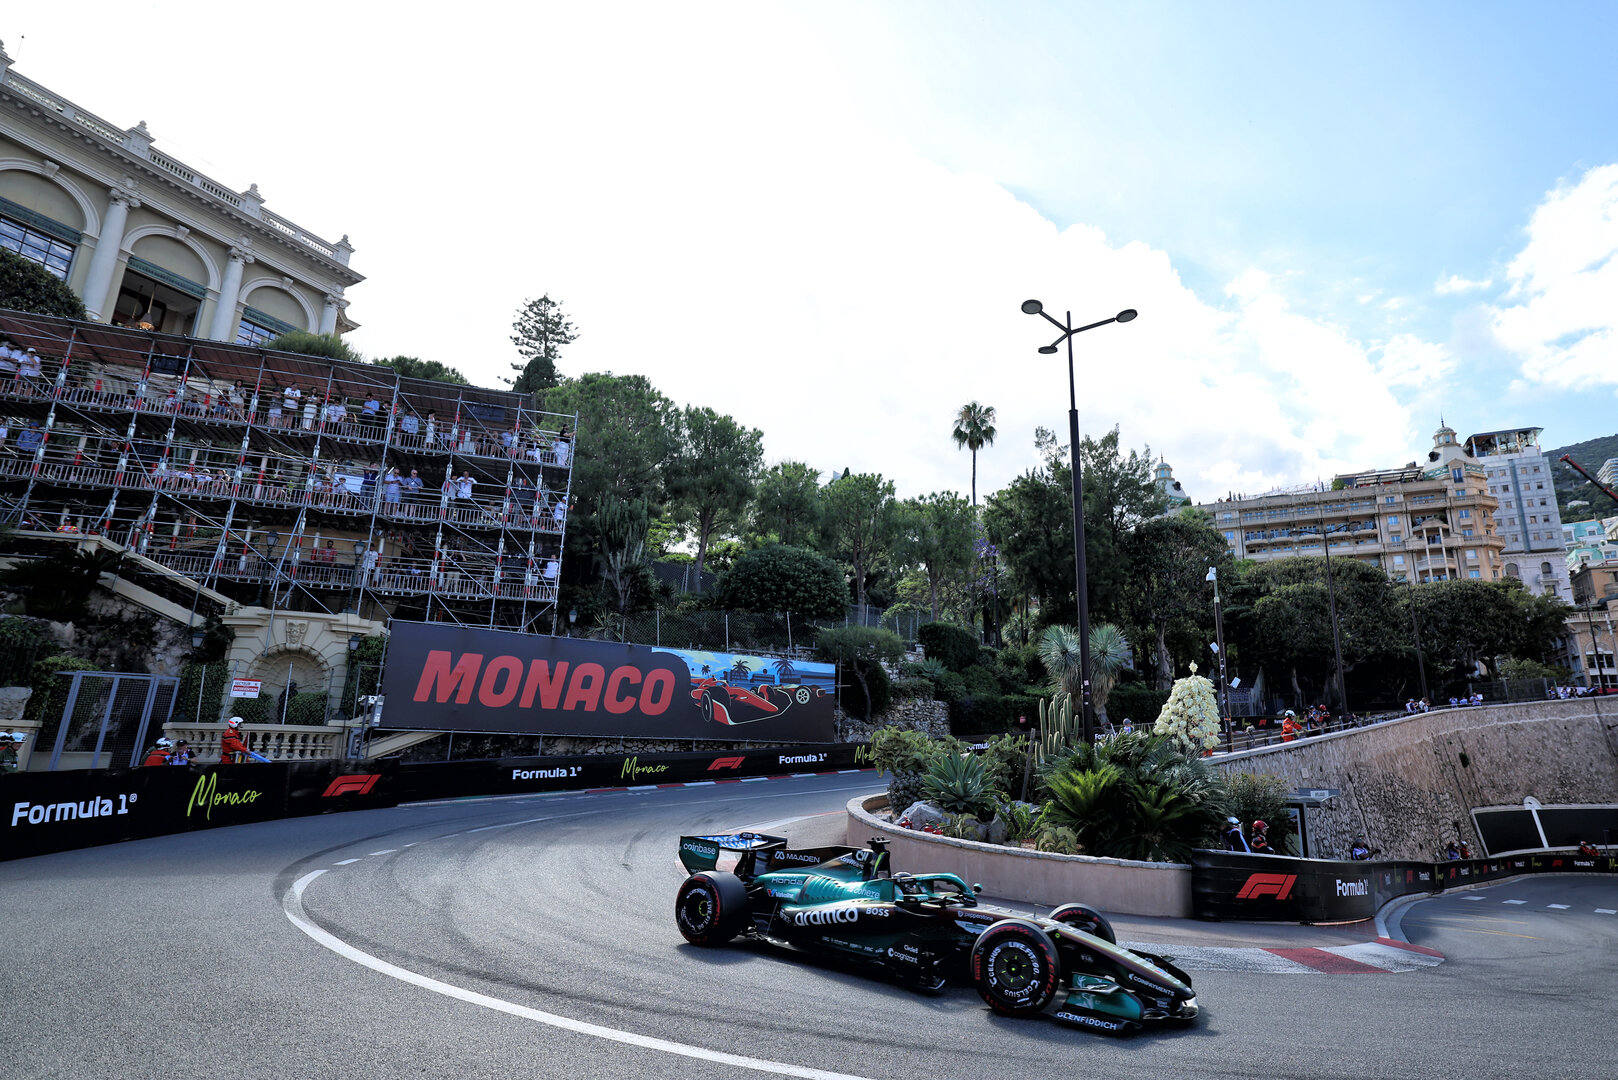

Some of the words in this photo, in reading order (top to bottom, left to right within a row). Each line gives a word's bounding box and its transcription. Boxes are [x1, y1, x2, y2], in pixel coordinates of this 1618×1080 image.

[413, 650, 676, 716] MONACO
[706, 756, 746, 770] F1
[779, 754, 817, 764] Formula
[512, 767, 567, 780] Formula
[621, 756, 669, 781] Monaco
[321, 774, 382, 797] F1
[187, 772, 262, 820] Monaco
[11, 796, 113, 826] Formula
[683, 842, 716, 855] coinbase
[786, 853, 820, 863] MAADEN
[771, 877, 803, 885] Honda
[1236, 873, 1298, 900] F1
[1336, 879, 1364, 896] Formula
[794, 907, 858, 926] aramco
[865, 907, 889, 918] BOSS
[1004, 985, 1033, 997] CELSIUS
[1057, 1011, 1117, 1030] GLENFIDDICH
